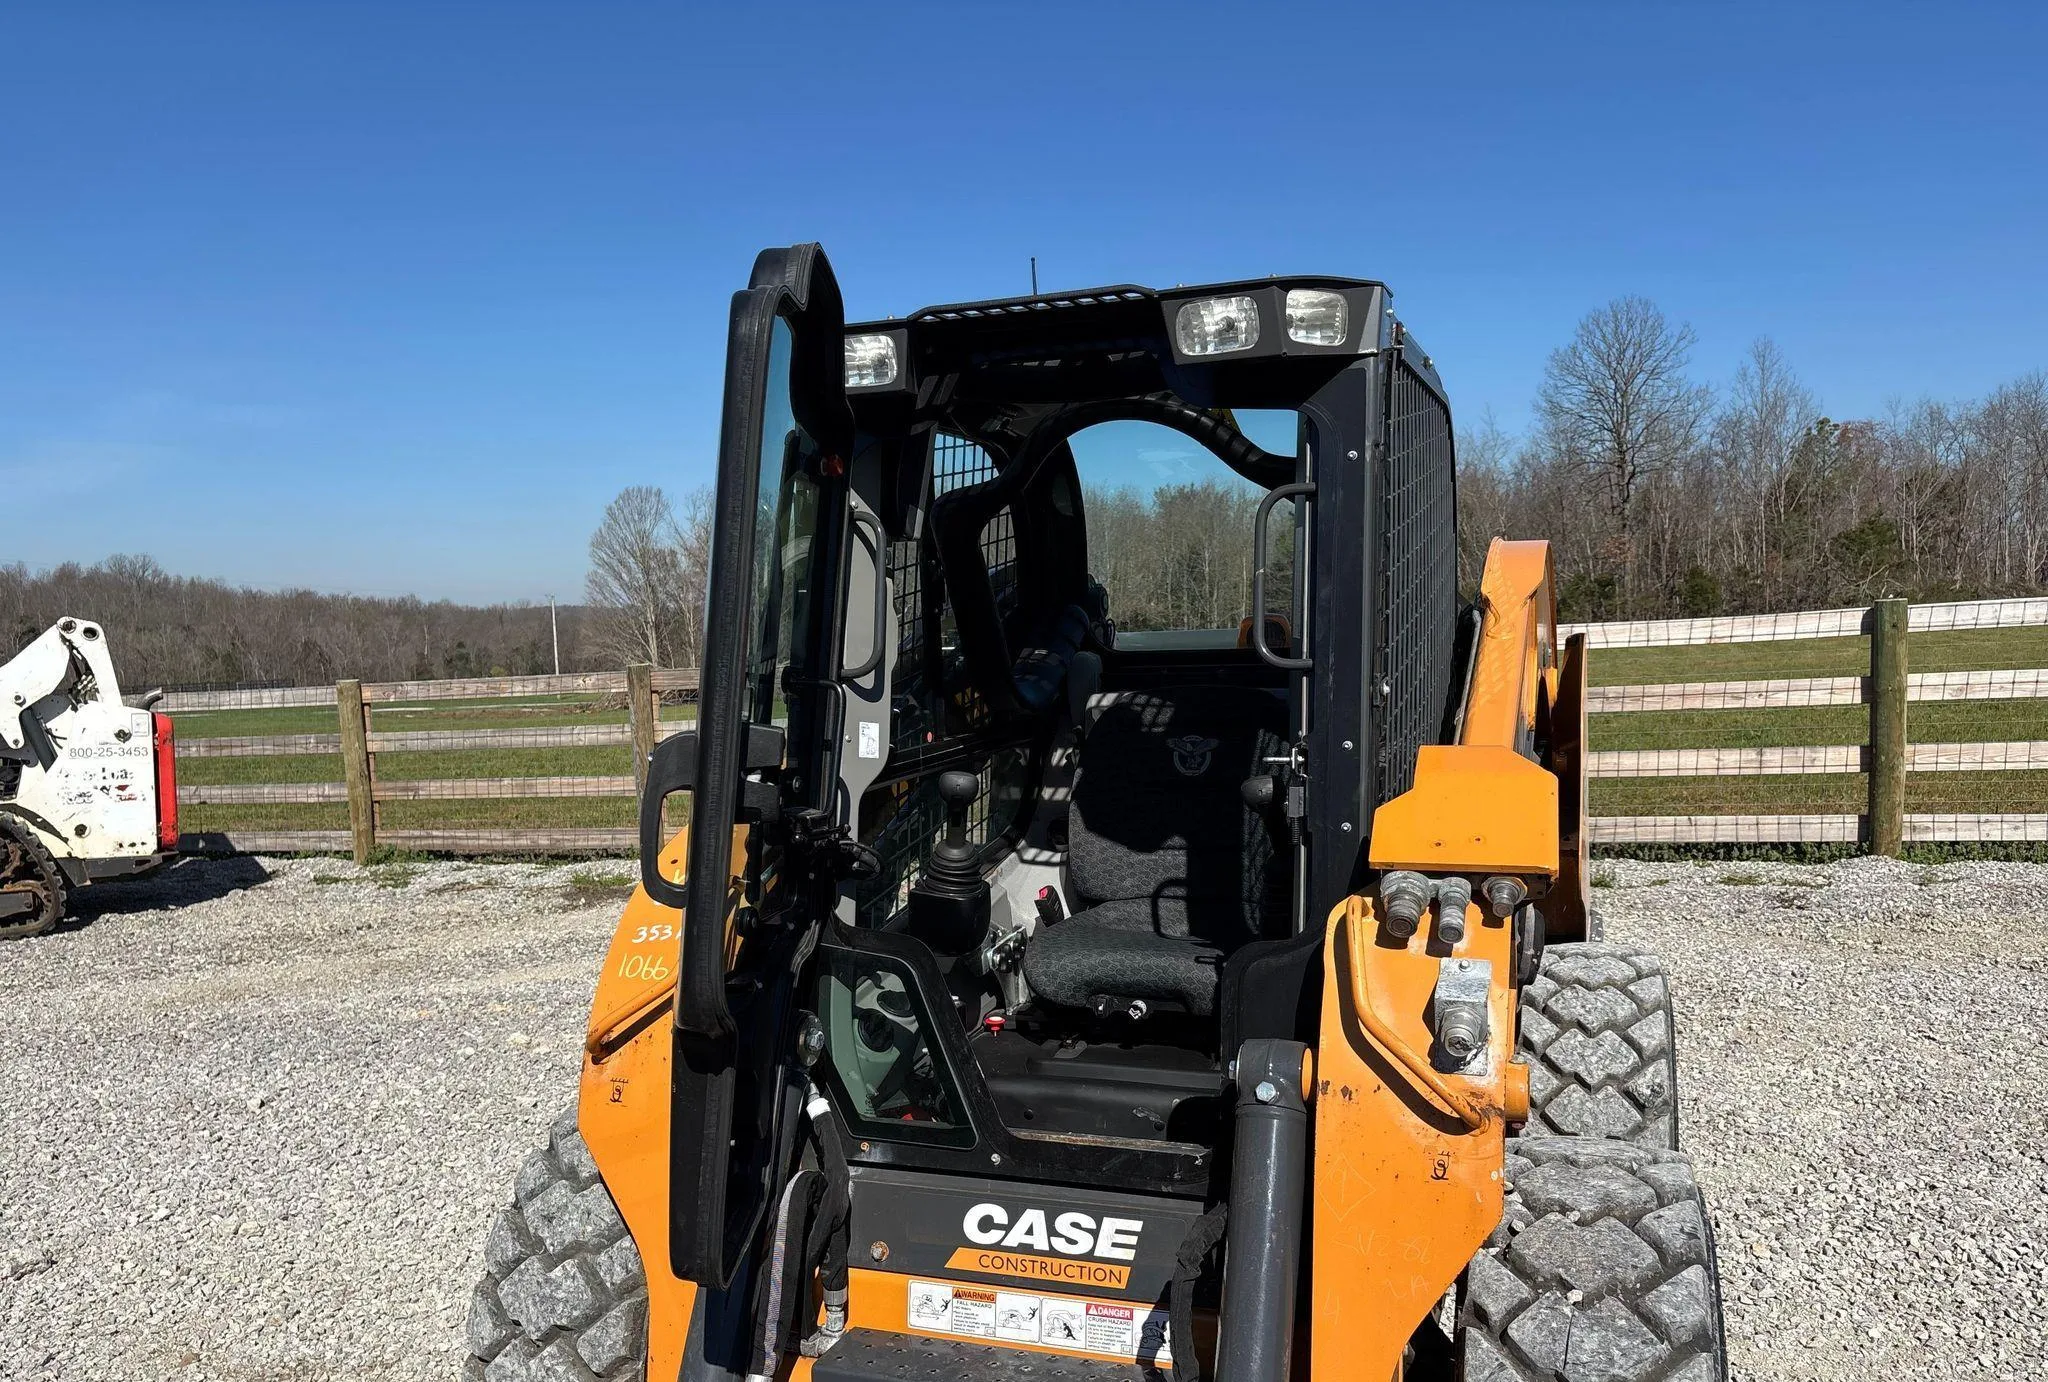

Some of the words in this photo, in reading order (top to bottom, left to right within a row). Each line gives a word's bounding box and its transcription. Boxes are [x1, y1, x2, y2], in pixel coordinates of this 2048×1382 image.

[69, 746, 149, 758] 800-25-3453
[631, 924, 682, 944] 353
[618, 953, 669, 981] 1066
[963, 1203, 1144, 1261] CASE
[978, 1254, 1122, 1285] CONSTRUCTION
[961, 1289, 995, 1302] WARNING
[970, 1301, 992, 1309] HAZARD
[1097, 1307, 1131, 1319] DANGER
